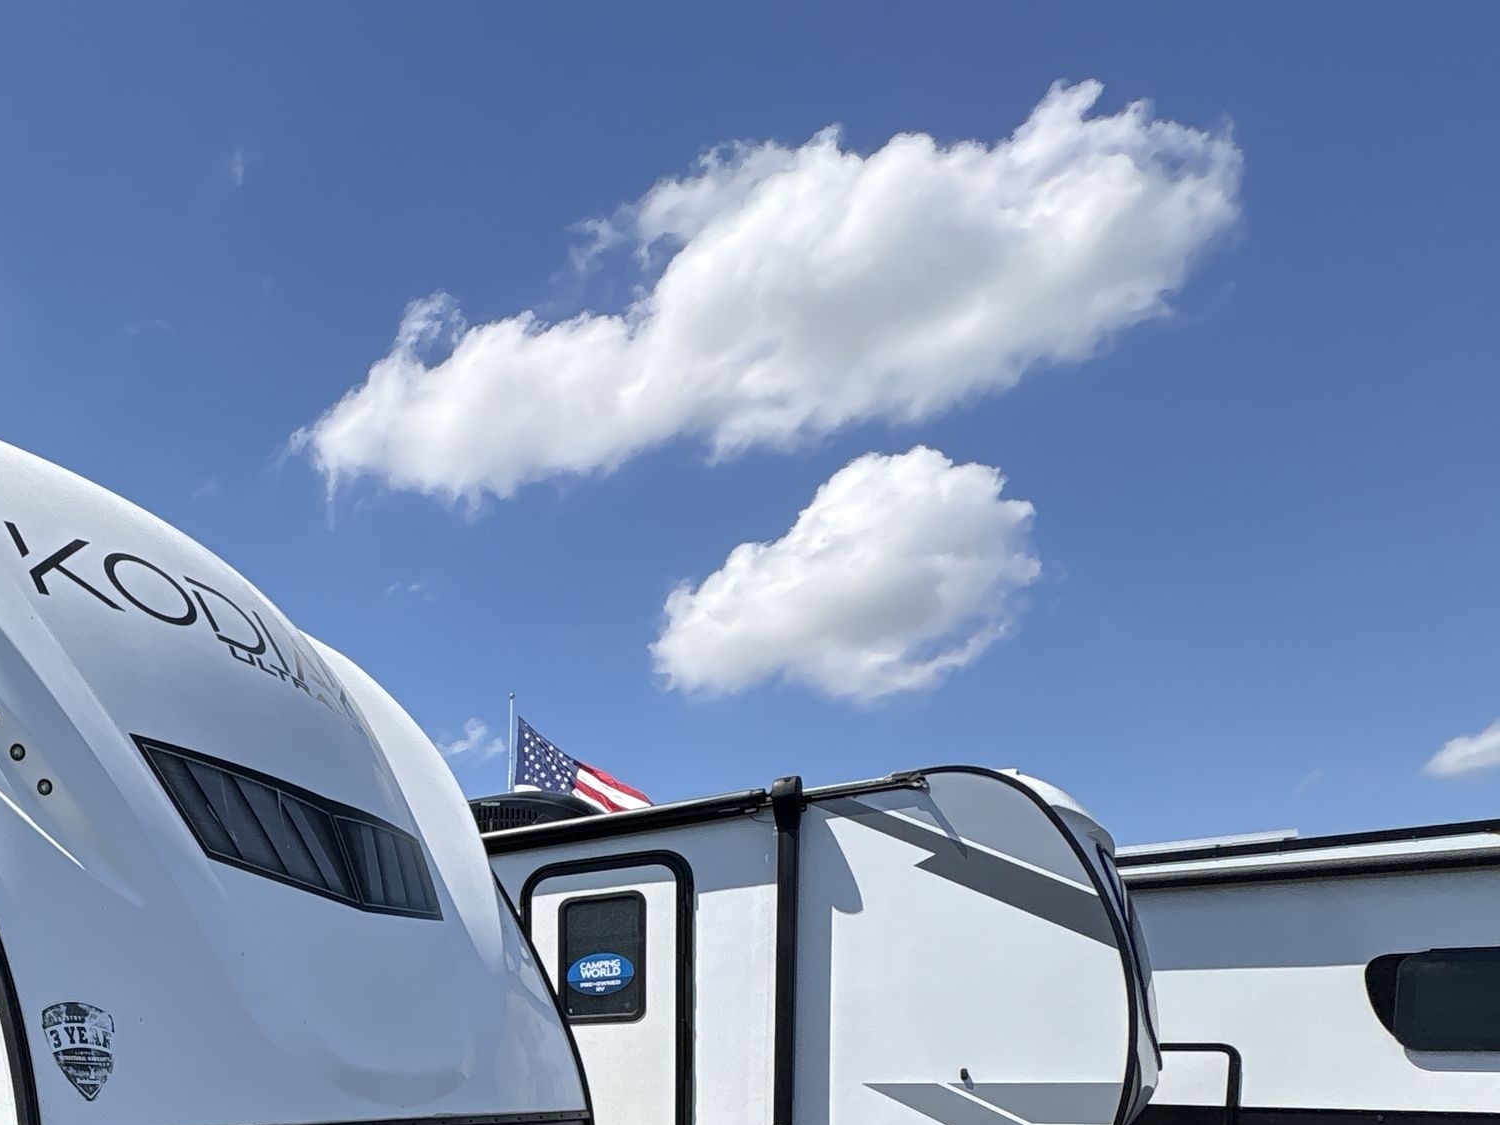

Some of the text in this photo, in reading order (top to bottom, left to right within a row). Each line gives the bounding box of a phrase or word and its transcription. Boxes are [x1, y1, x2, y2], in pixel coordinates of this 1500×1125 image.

[579, 959, 621, 970] CAMPING
[580, 967, 621, 979] WORLD
[580, 980, 621, 988] PRE-OWNED
[49, 1029, 62, 1049] 3
